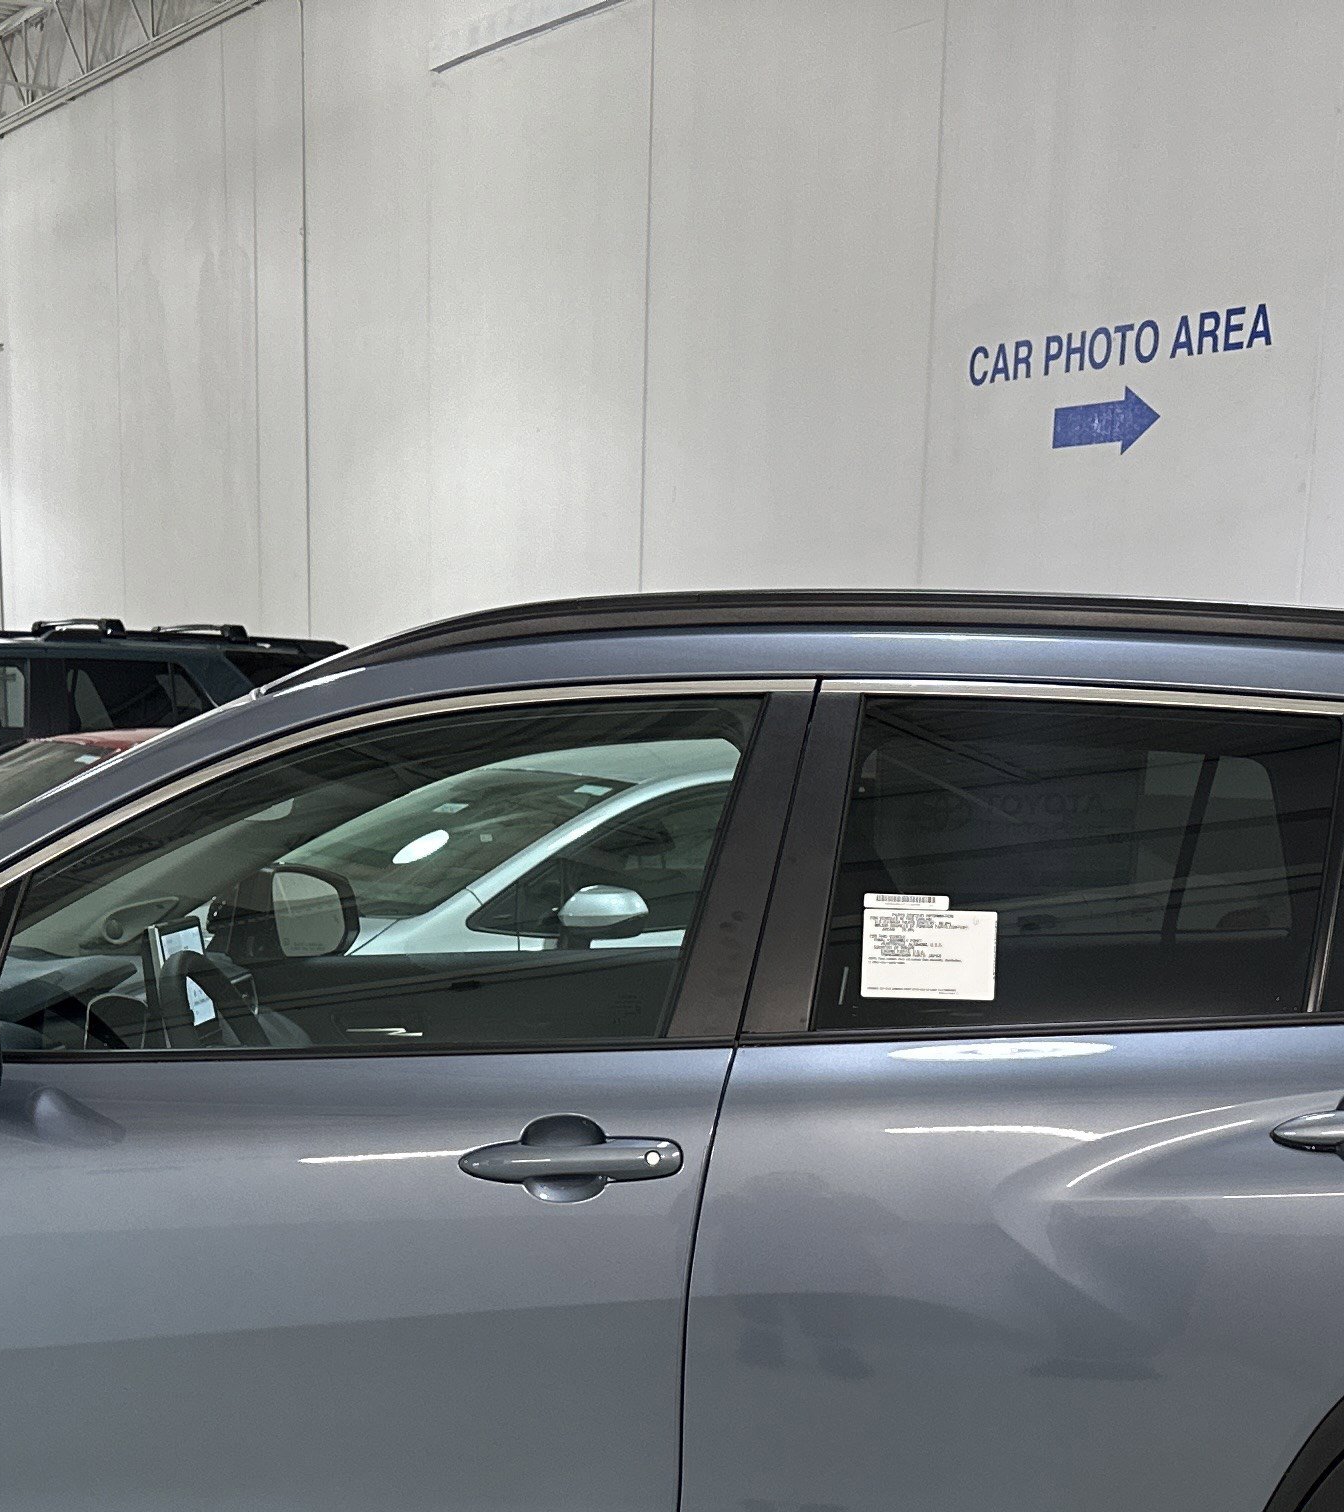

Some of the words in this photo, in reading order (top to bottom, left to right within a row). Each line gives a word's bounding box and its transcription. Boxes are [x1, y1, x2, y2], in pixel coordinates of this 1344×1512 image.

[968, 339, 1034, 387] CAR
[1043, 319, 1160, 376] PHOTO
[1169, 302, 1273, 360] AREA
